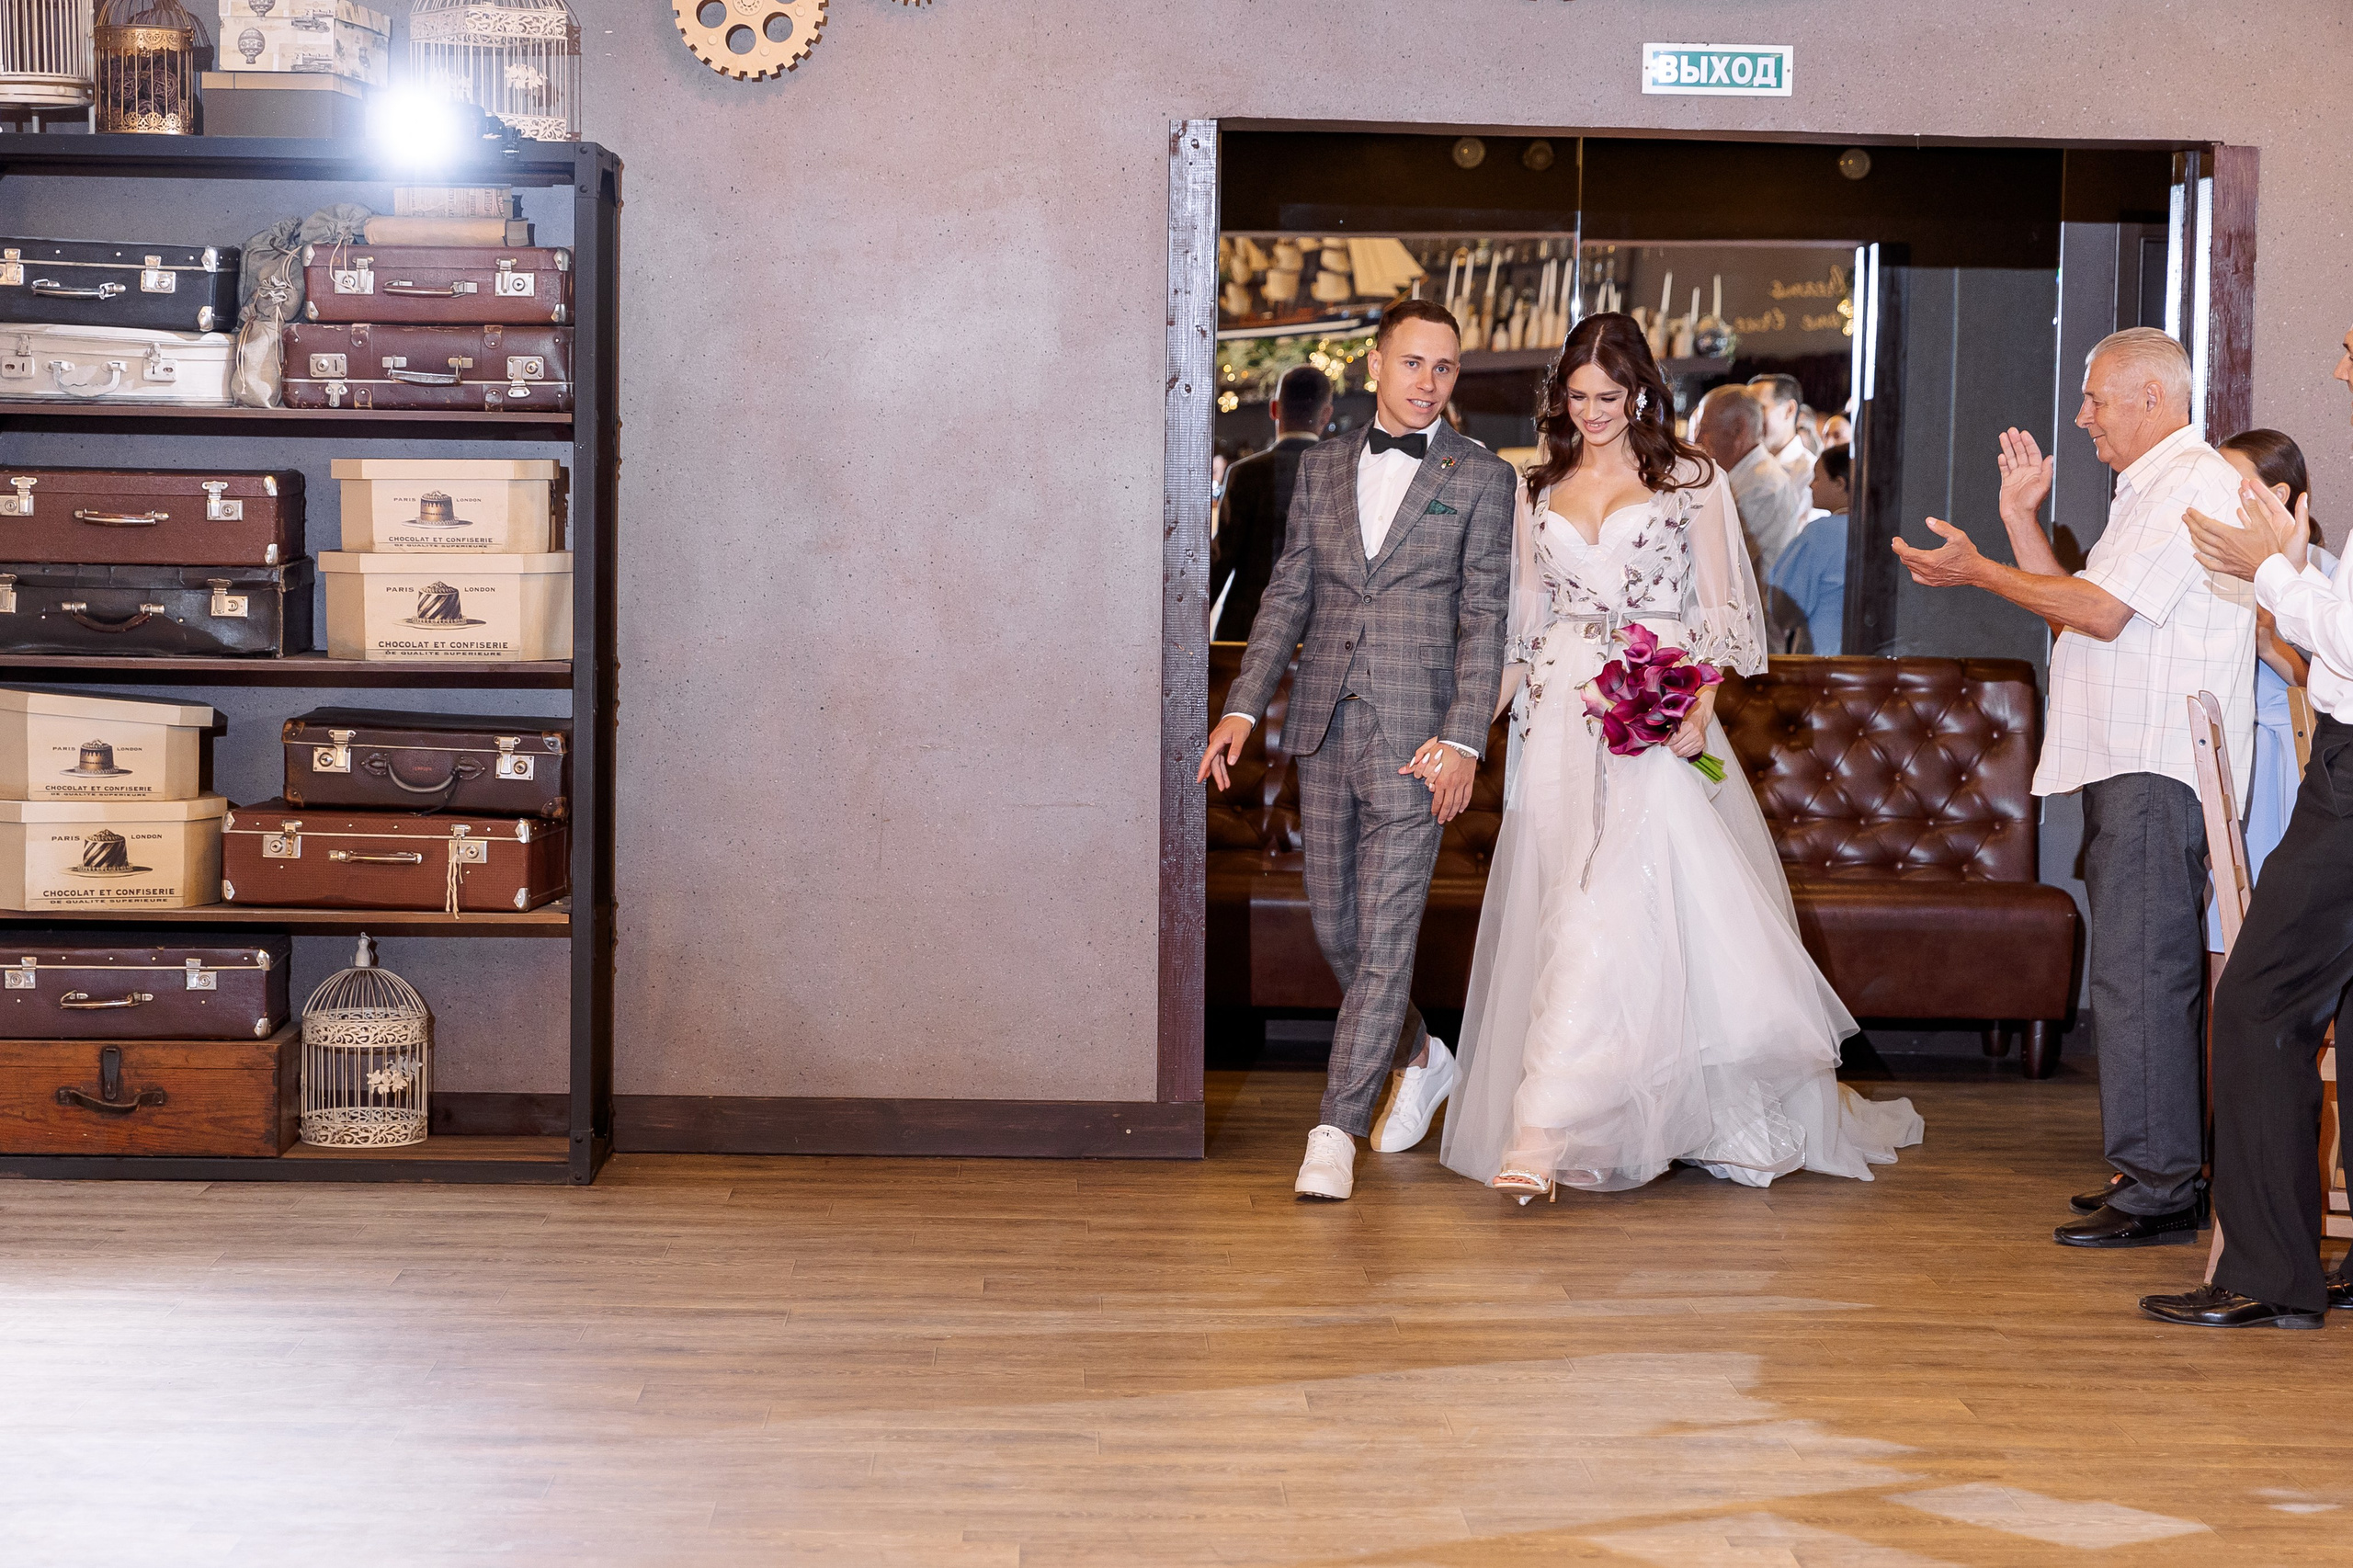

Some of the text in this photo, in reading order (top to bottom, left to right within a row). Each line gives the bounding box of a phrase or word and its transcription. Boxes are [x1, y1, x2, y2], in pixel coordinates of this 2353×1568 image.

[1658, 54, 1777, 87] ВЫХОД
[378, 641, 508, 649] CHOCOLAT ET CONFISERIE
[43, 889, 95, 897] CHOCOLAT
